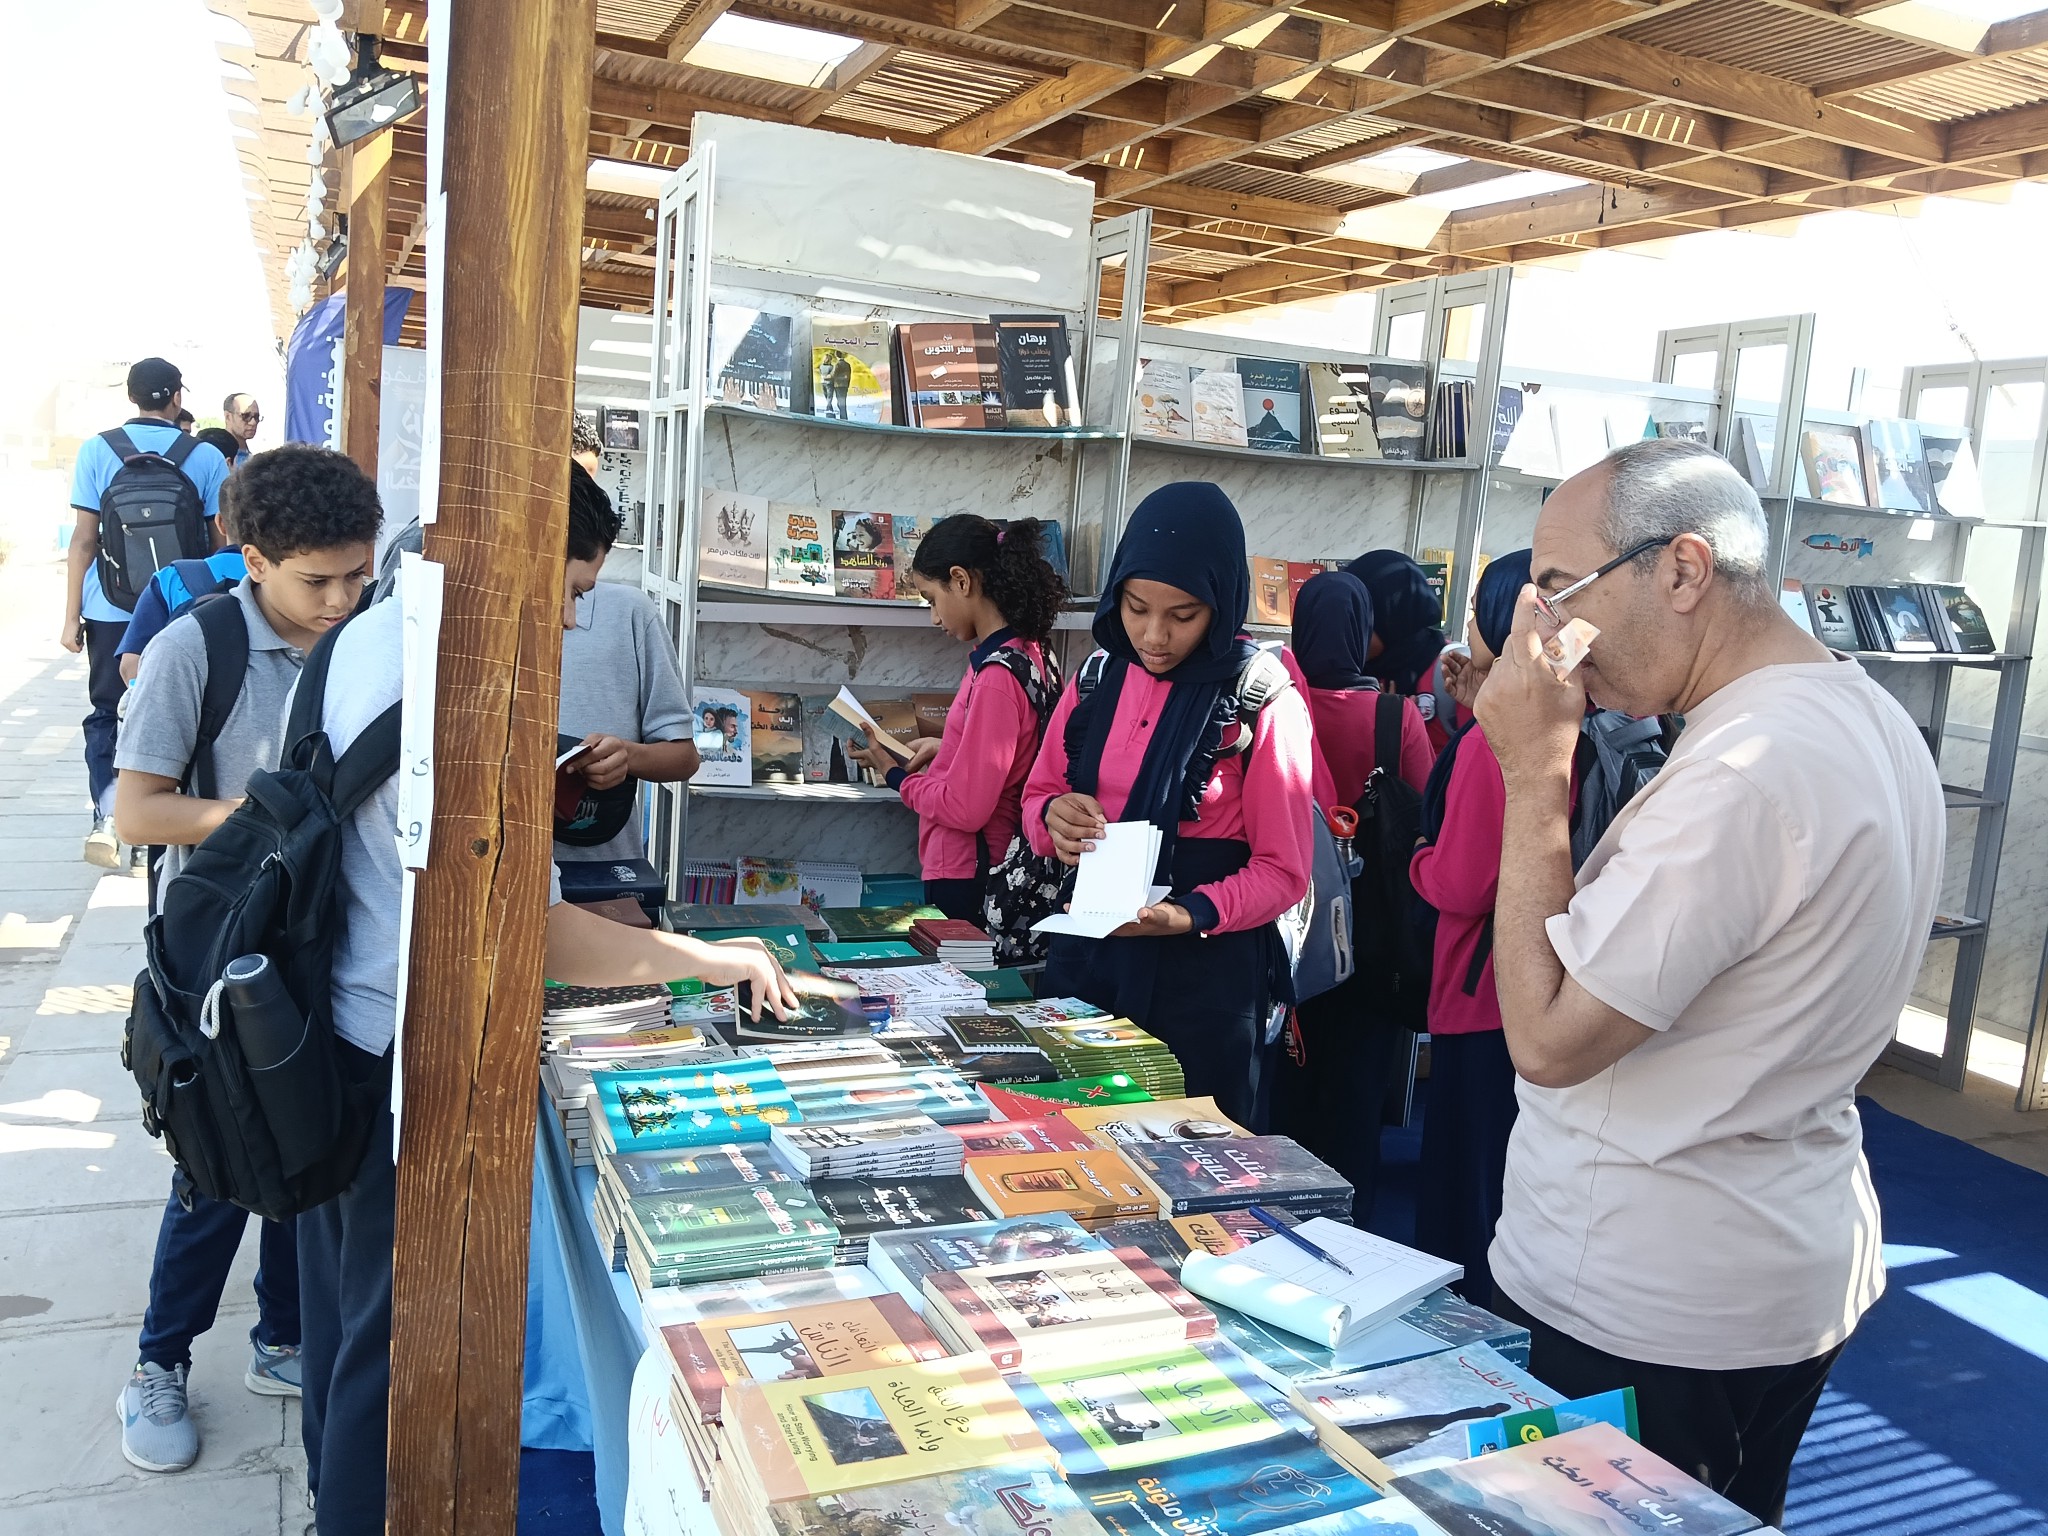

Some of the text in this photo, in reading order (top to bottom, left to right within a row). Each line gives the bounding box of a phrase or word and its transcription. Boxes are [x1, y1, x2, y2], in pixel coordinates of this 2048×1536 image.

[824, 333, 861, 347] المحبة
[924, 342, 974, 355] سفر التكوين
[1018, 332, 1047, 346] برهان
[1329, 407, 1358, 415] يسوع
[840, 553, 874, 567] الشاهد
[779, 716, 793, 725] إلى
[1179, 1143, 1247, 1190] العلاقات
[1224, 1148, 1269, 1180] مثلث
[818, 1320, 837, 1331] مع
[842, 1319, 878, 1353] التعامل
[799, 1326, 853, 1368] الناس
[732, 1360, 744, 1376] Dealing
[1459, 1355, 1518, 1391] القلب
[888, 1381, 927, 1418] الحياة
[927, 1384, 970, 1434] دع القلق
[777, 1412, 802, 1455] and Start Living
[785, 1403, 795, 1416] How
[794, 1422, 805, 1436] Stop
[801, 1435, 818, 1462] Worrying
[1137, 1477, 1183, 1518] ملونة
[1638, 1498, 1684, 1528] إلى
